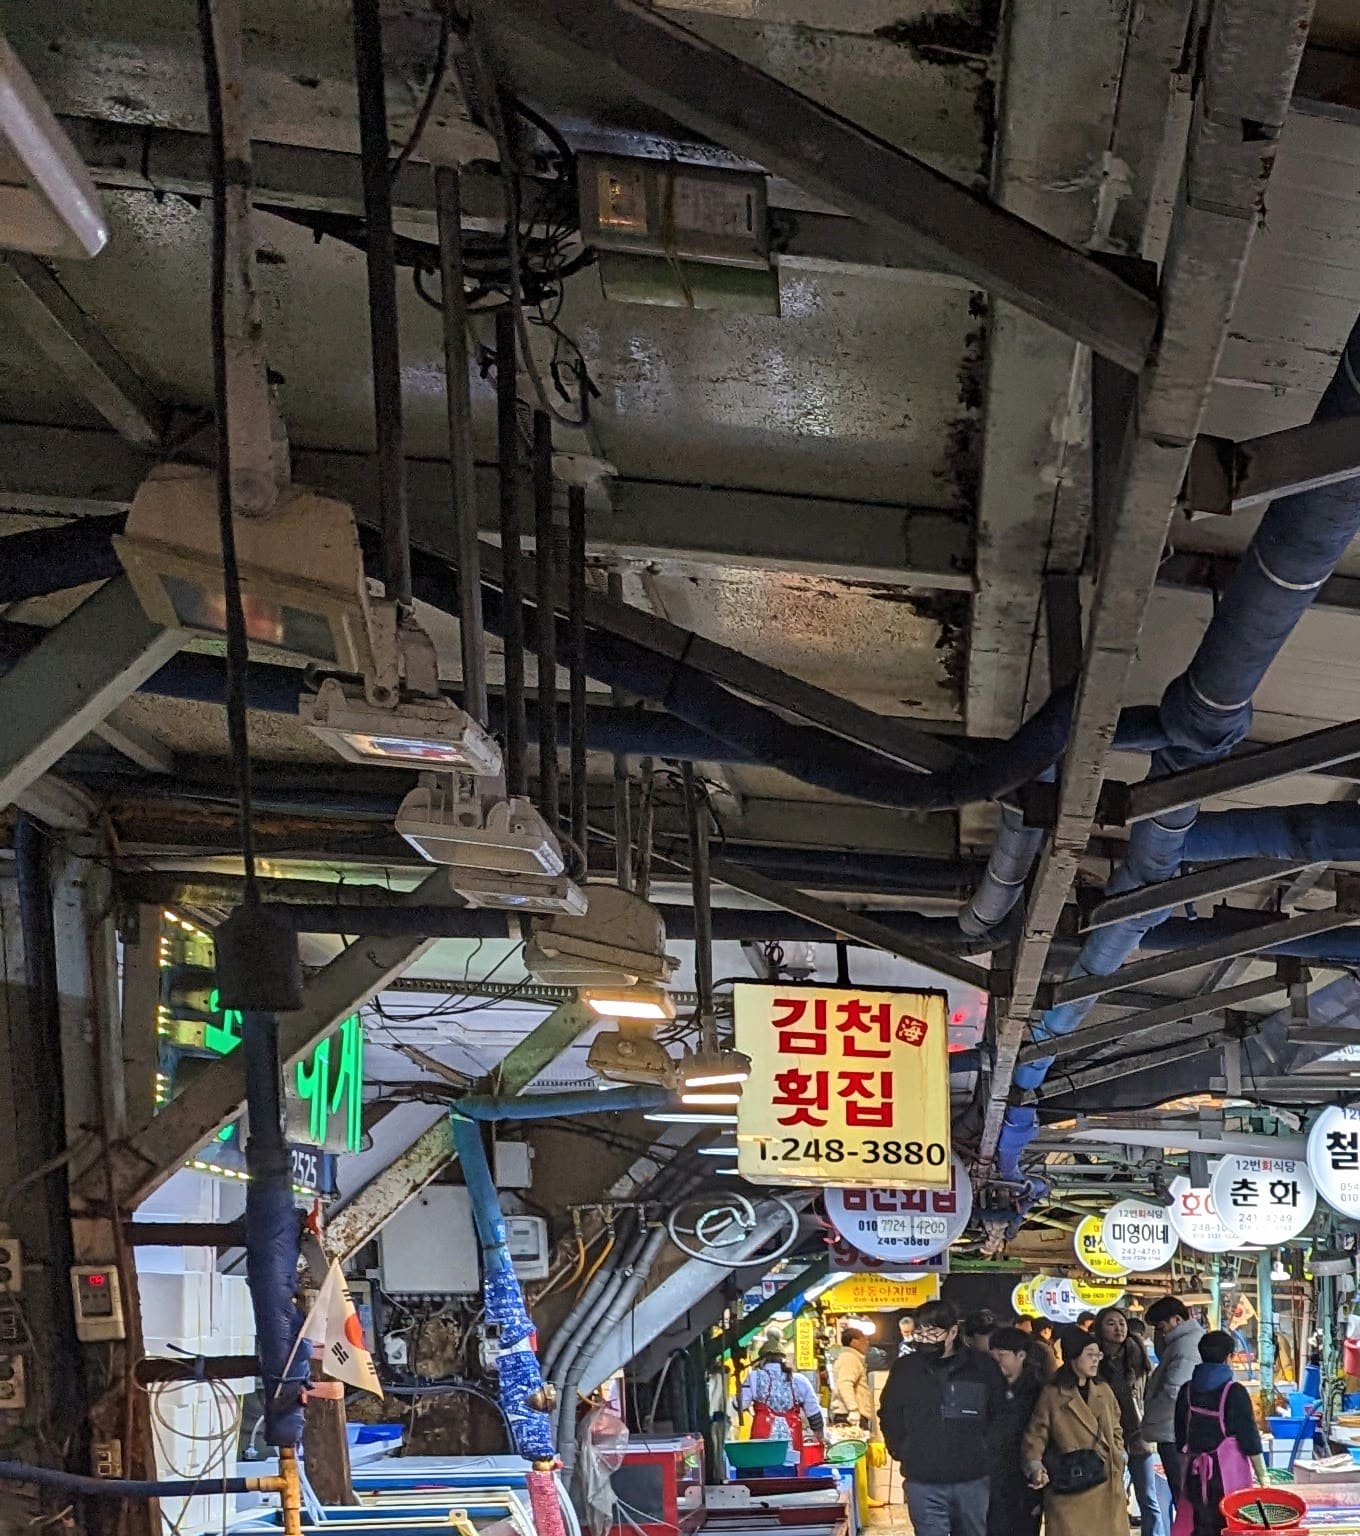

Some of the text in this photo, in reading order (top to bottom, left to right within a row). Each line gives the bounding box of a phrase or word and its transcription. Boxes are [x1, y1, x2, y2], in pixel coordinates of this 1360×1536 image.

[771, 998, 892, 1059] 김천
[772, 1068, 894, 1128] 횟집
[1235, 1159, 1297, 1173] 12번회식당
[1112, 1223, 1169, 1244] 미영이네
